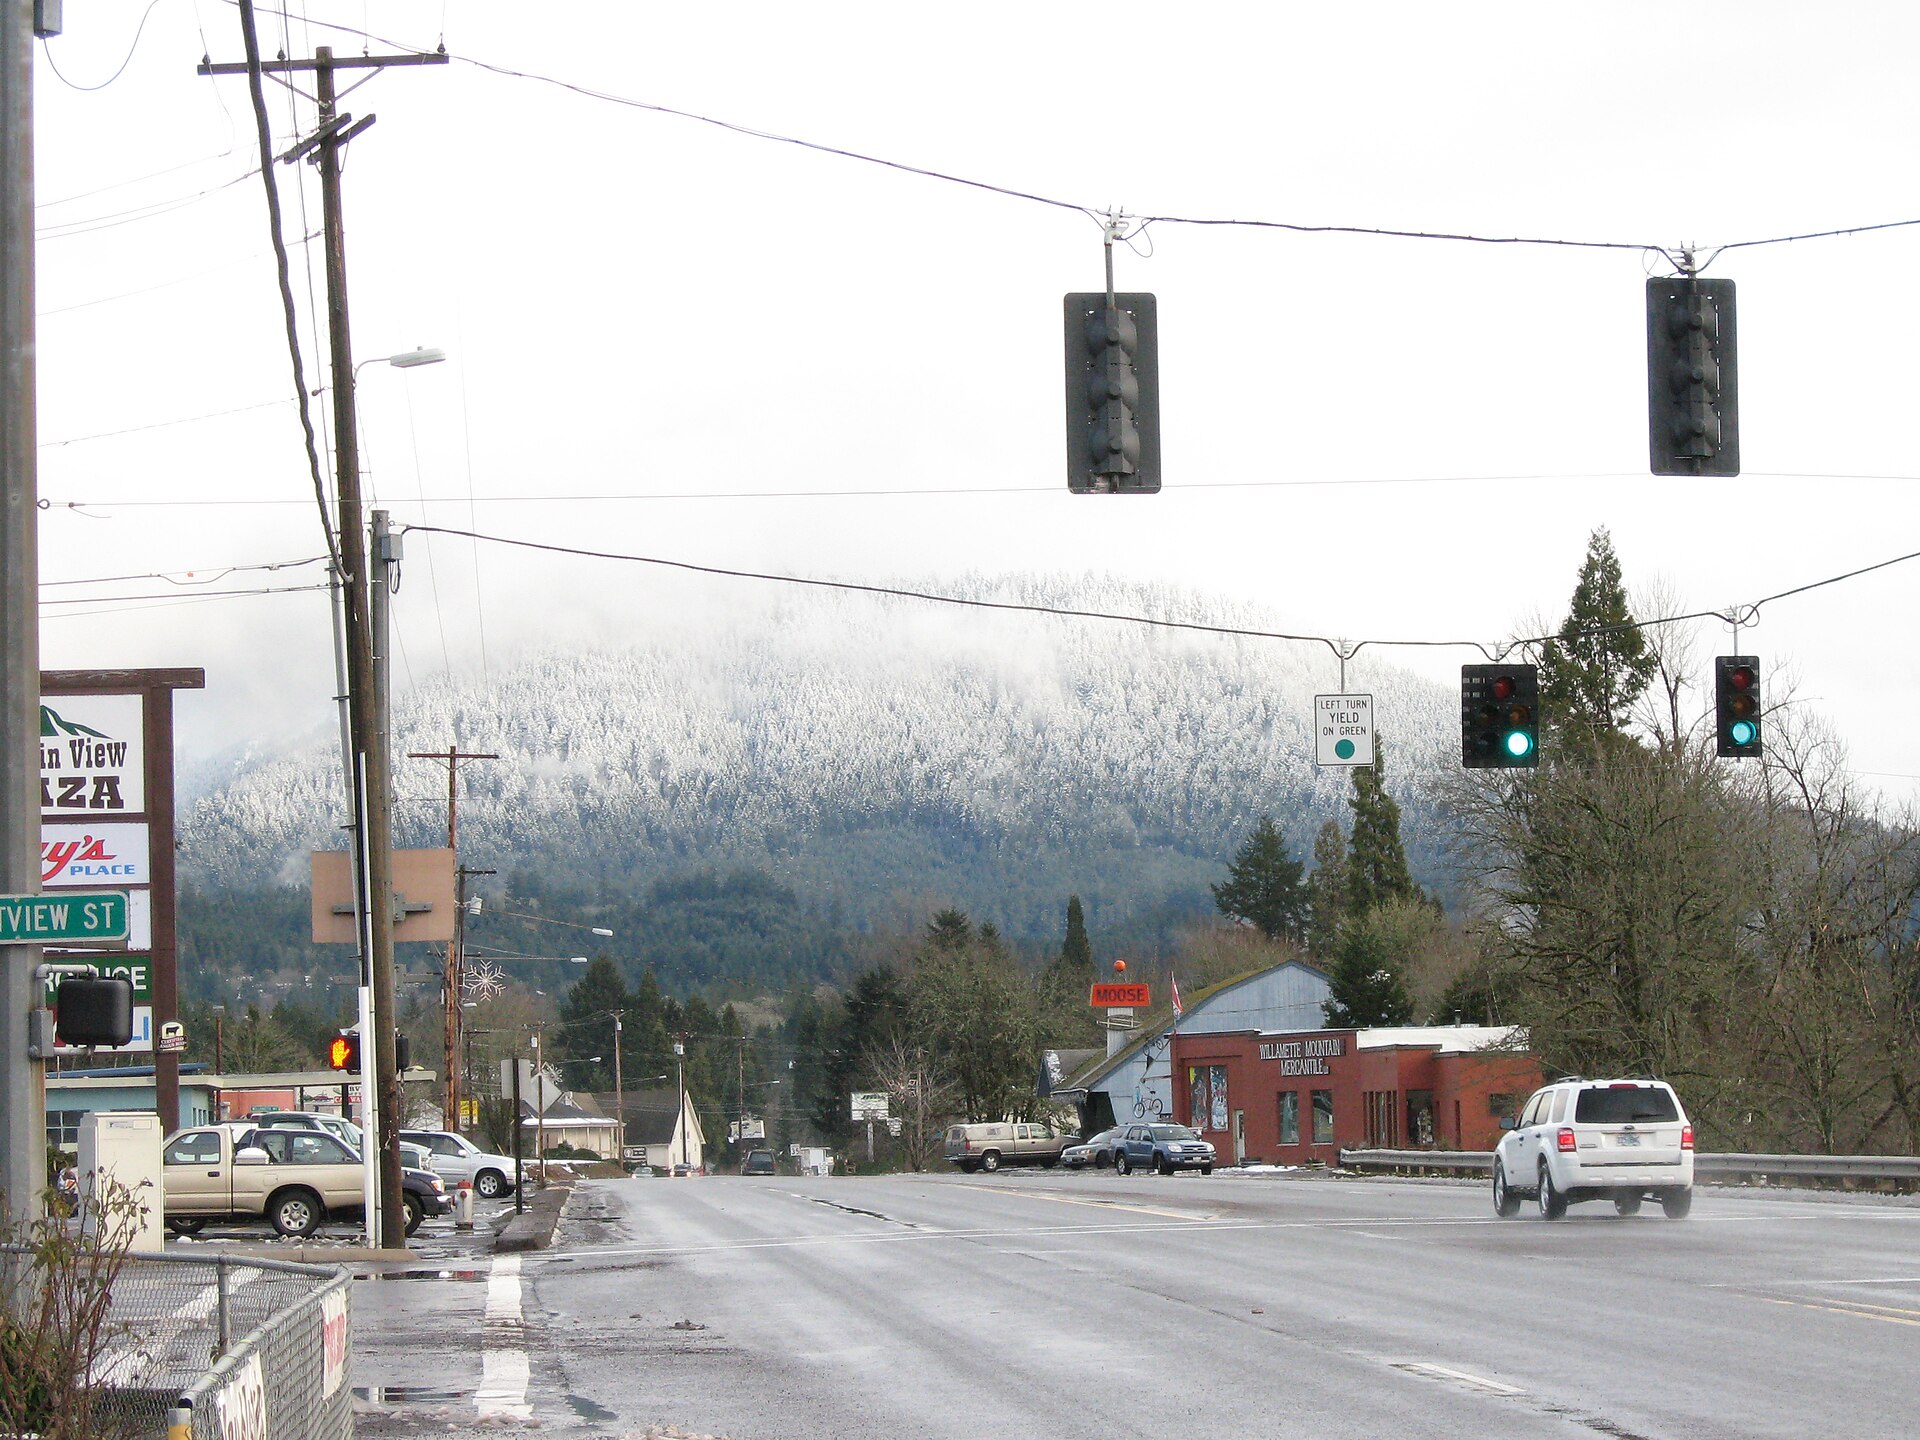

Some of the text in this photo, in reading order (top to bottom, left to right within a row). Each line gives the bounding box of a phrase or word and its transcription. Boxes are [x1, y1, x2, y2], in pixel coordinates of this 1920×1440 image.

[1321, 700, 1367, 709] LEFT TURN
[1330, 712, 1359, 723] YIELD
[1323, 726, 1366, 736] ON GREEN
[69, 737, 127, 768] View
[70, 864, 135, 876] PLACE
[83, 902, 115, 930] ST
[1097, 988, 1145, 1002] MOOSE
[1260, 1039, 1341, 1059] WILLAMETTE MOUNTAIN
[1280, 1058, 1324, 1076] MERCANTILE
